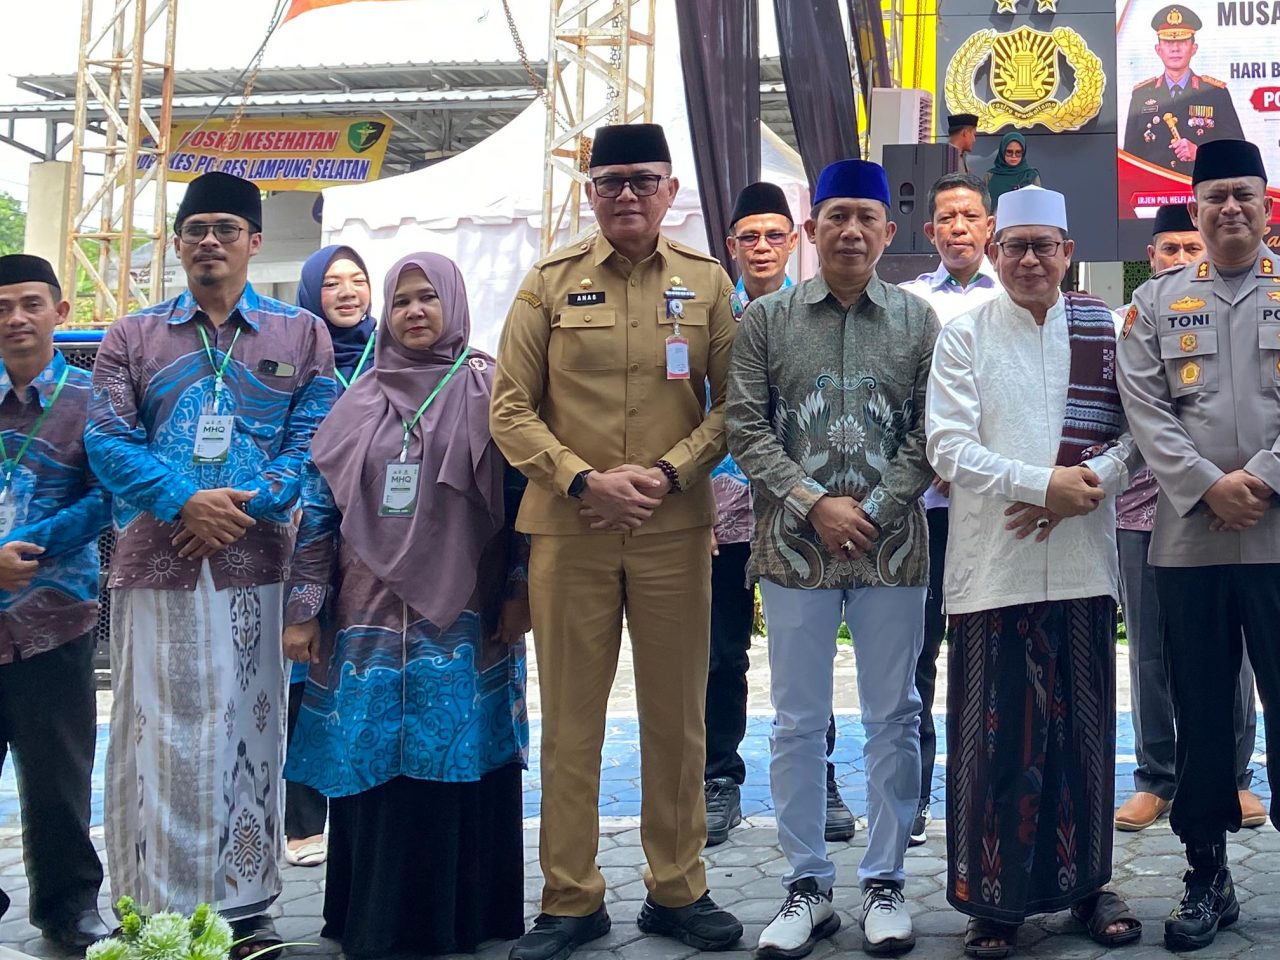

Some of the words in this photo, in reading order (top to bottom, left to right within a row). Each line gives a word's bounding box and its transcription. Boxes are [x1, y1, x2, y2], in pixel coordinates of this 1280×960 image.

[1230, 62, 1266, 79] HARI
[243, 130, 339, 152] KESEHATAN
[195, 155, 248, 178] PORES
[250, 158, 311, 180] LAMPUNG
[313, 159, 371, 182] SELATAN
[1168, 313, 1210, 328] TONI
